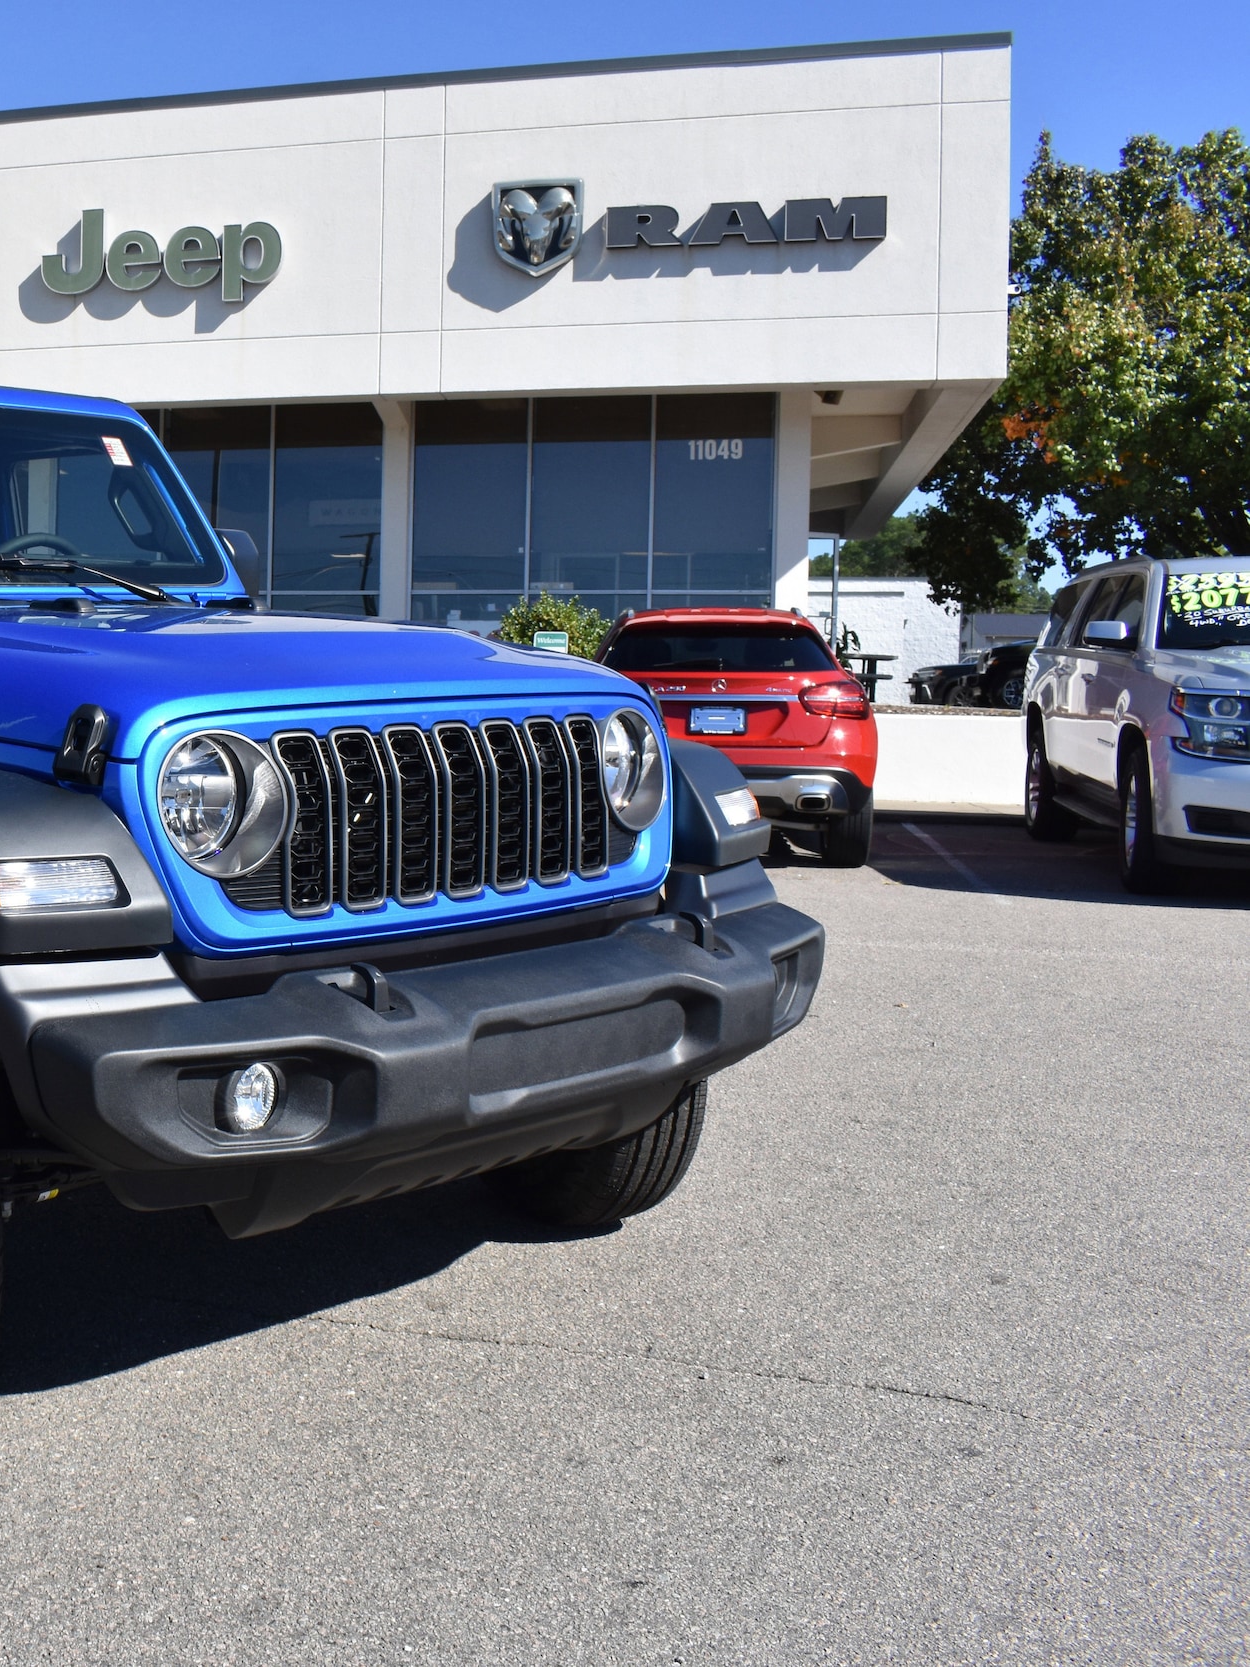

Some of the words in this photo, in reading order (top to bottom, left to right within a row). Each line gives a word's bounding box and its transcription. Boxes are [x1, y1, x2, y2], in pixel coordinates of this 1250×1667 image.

[608, 196, 887, 249] RAM
[41, 208, 283, 303] Jeep
[688, 439, 744, 460] 11049
